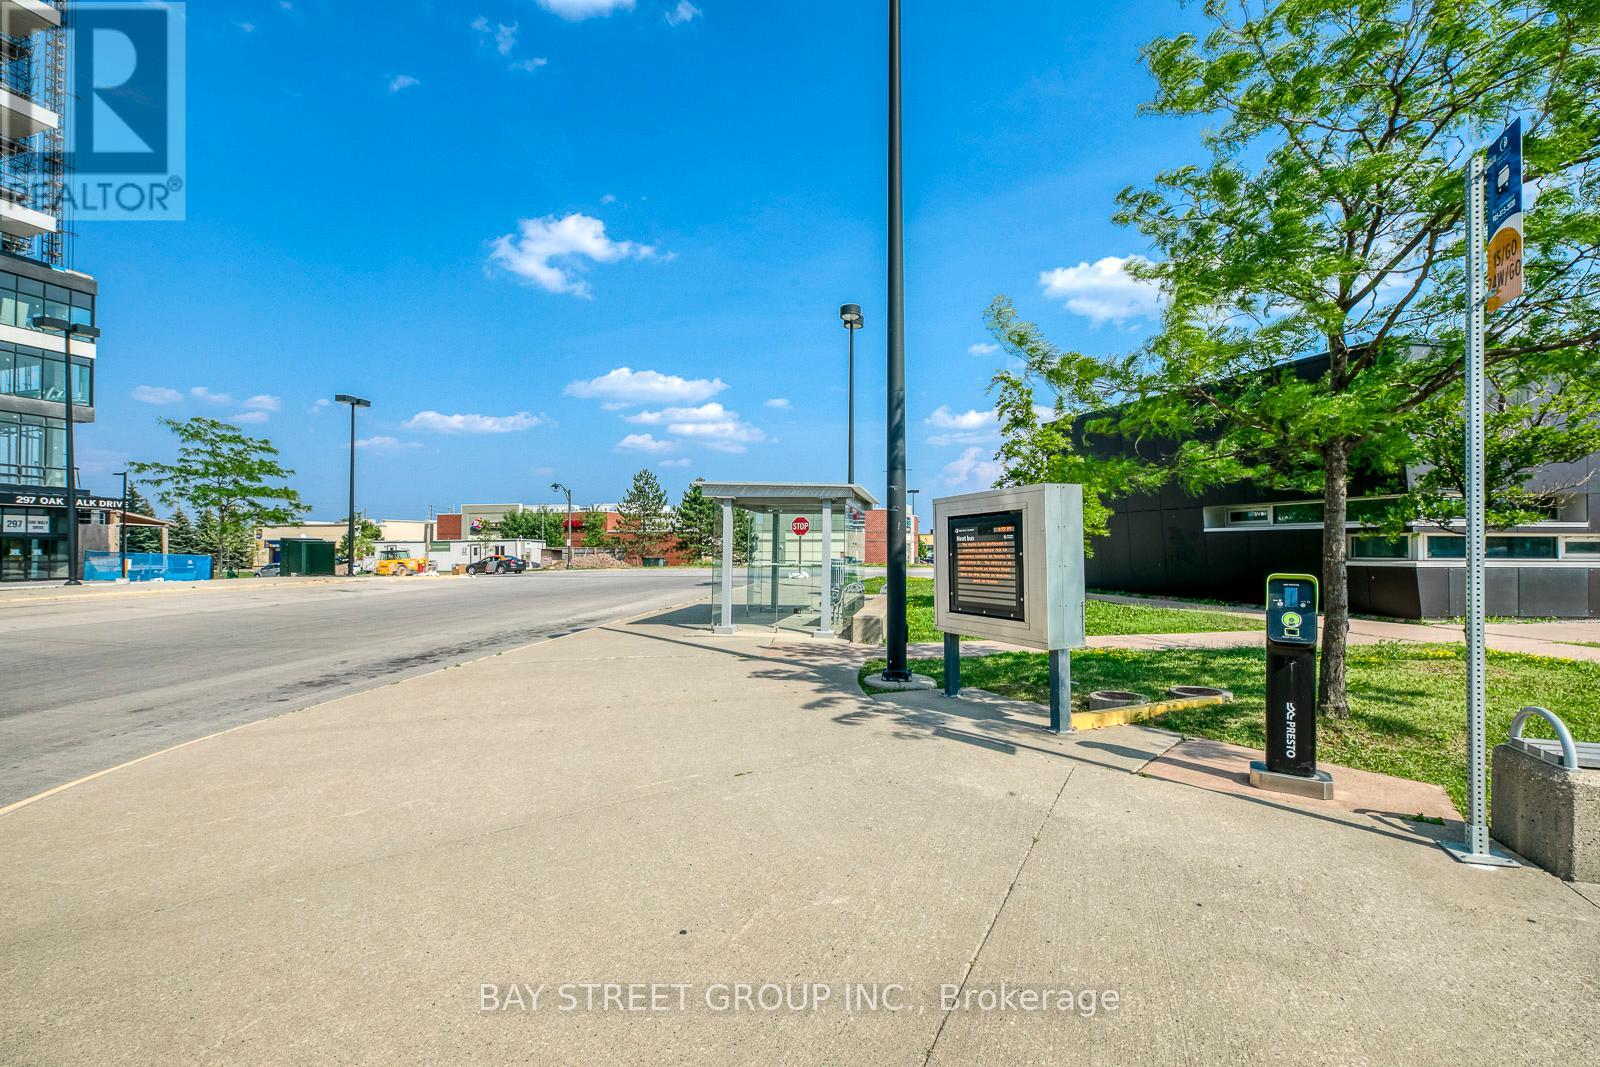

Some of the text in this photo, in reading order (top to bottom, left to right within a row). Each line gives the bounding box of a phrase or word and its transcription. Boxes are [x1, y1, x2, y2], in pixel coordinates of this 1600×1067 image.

[16, 496, 36, 504] 297
[40, 497, 64, 505] OAK
[76, 499, 97, 507] ALK
[7, 520, 23, 528] 297
[792, 522, 809, 531] STOP
[1286, 721, 1296, 759] PRESTO
